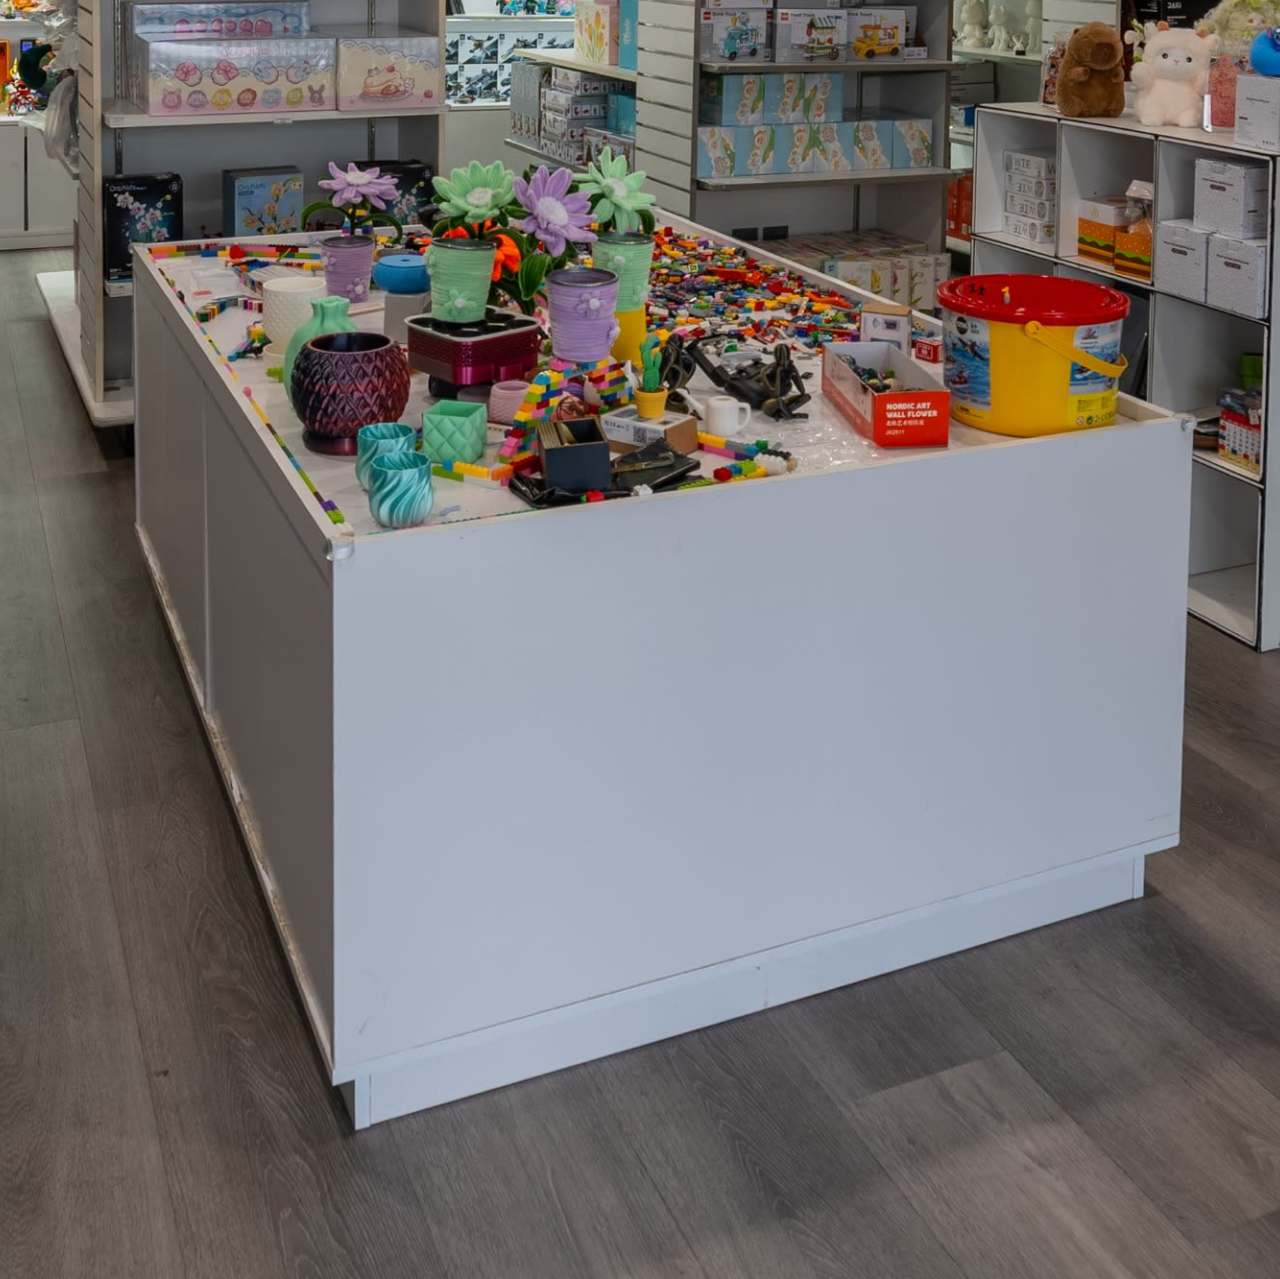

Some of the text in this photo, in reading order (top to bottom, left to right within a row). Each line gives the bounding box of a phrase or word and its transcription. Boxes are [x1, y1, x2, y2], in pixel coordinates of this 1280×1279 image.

[886, 401, 931, 410] NORDIC ART
[886, 410, 938, 419] WALL FLOWER
